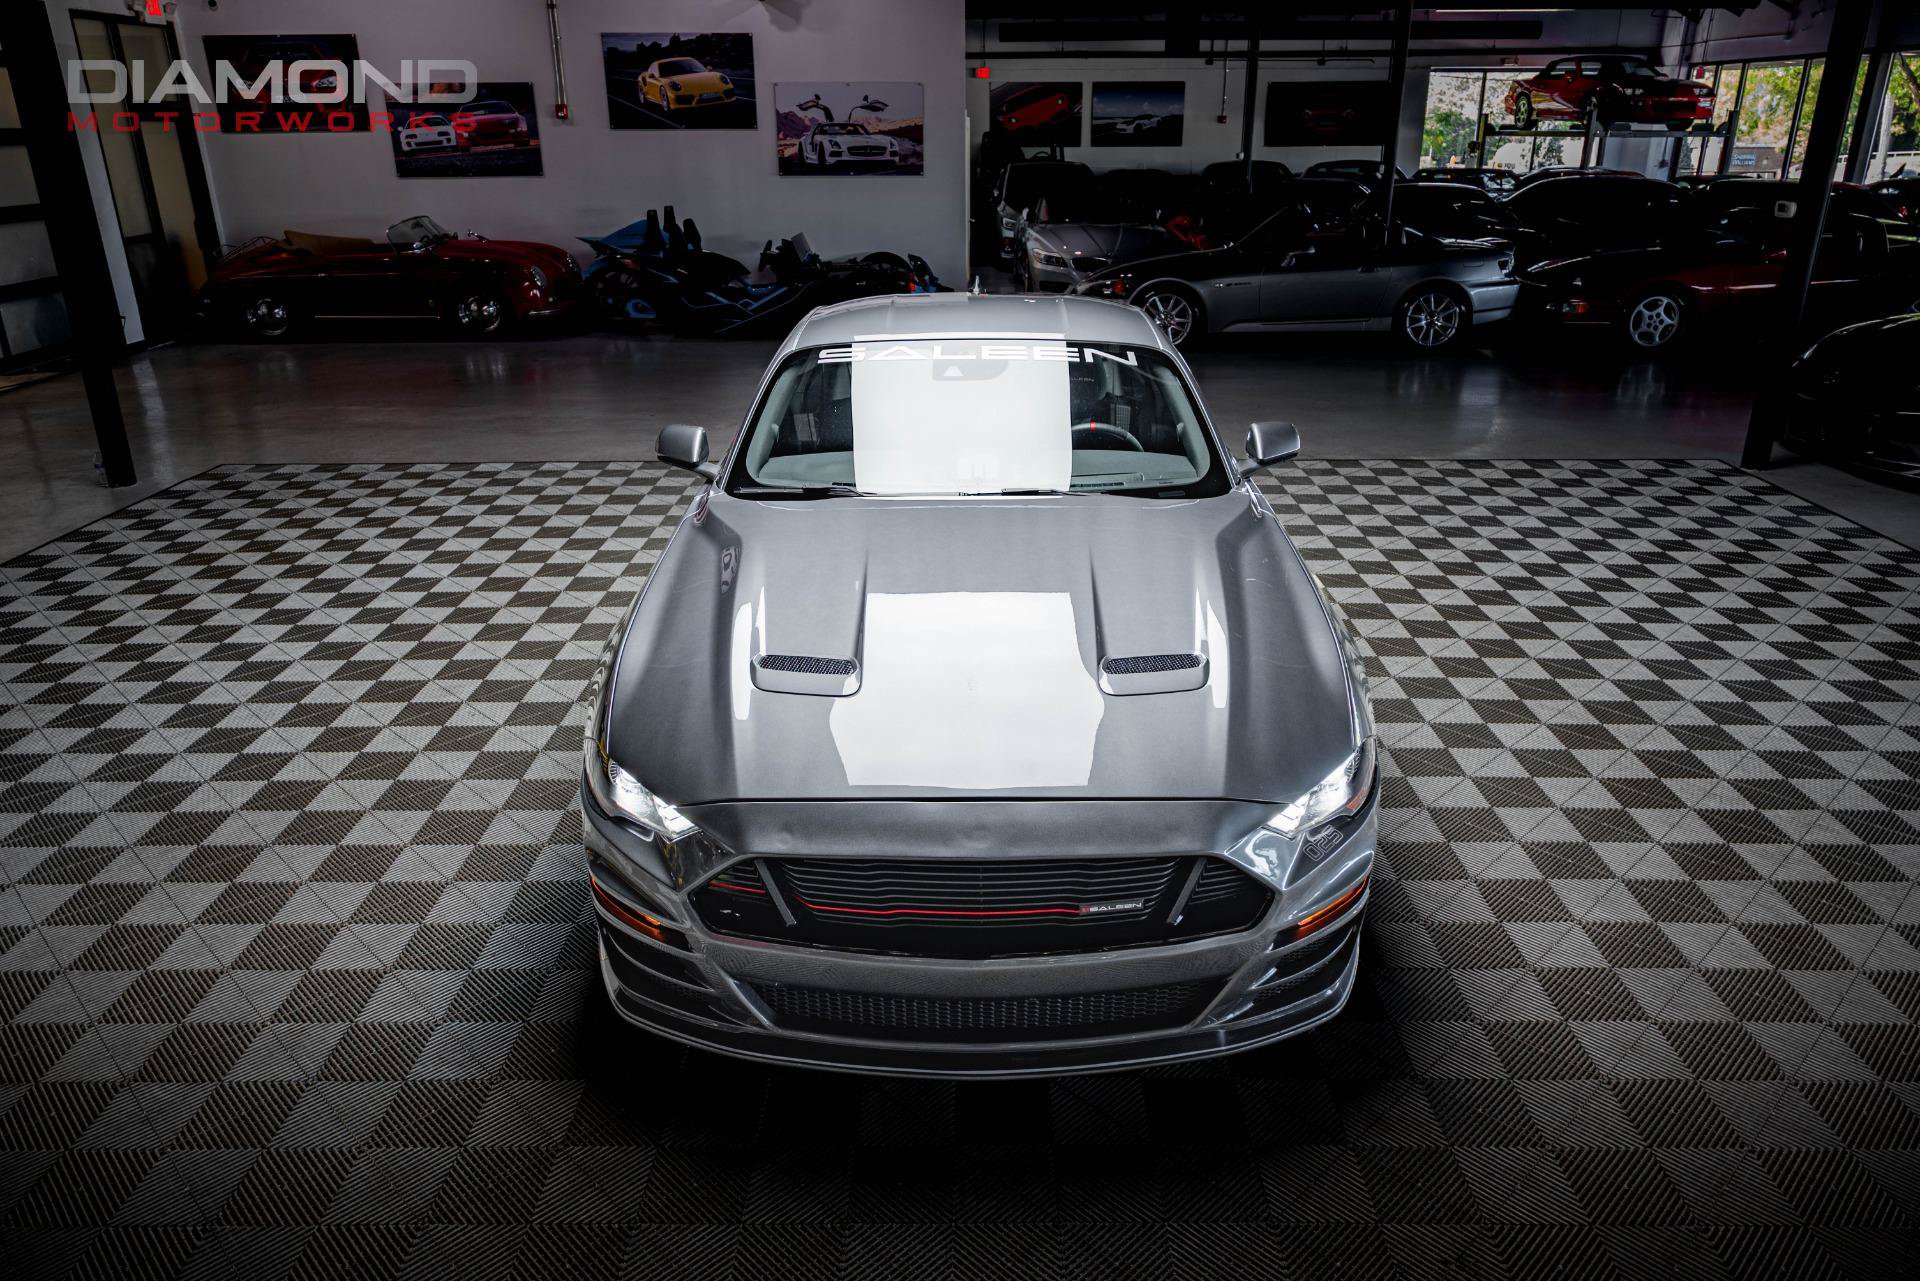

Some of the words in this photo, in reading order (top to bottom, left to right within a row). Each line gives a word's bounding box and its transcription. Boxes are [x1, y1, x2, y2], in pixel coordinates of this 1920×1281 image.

[817, 345, 1138, 366] SALEEN
[1302, 824, 1344, 861] 025
[1089, 902, 1142, 912] SALEEN
